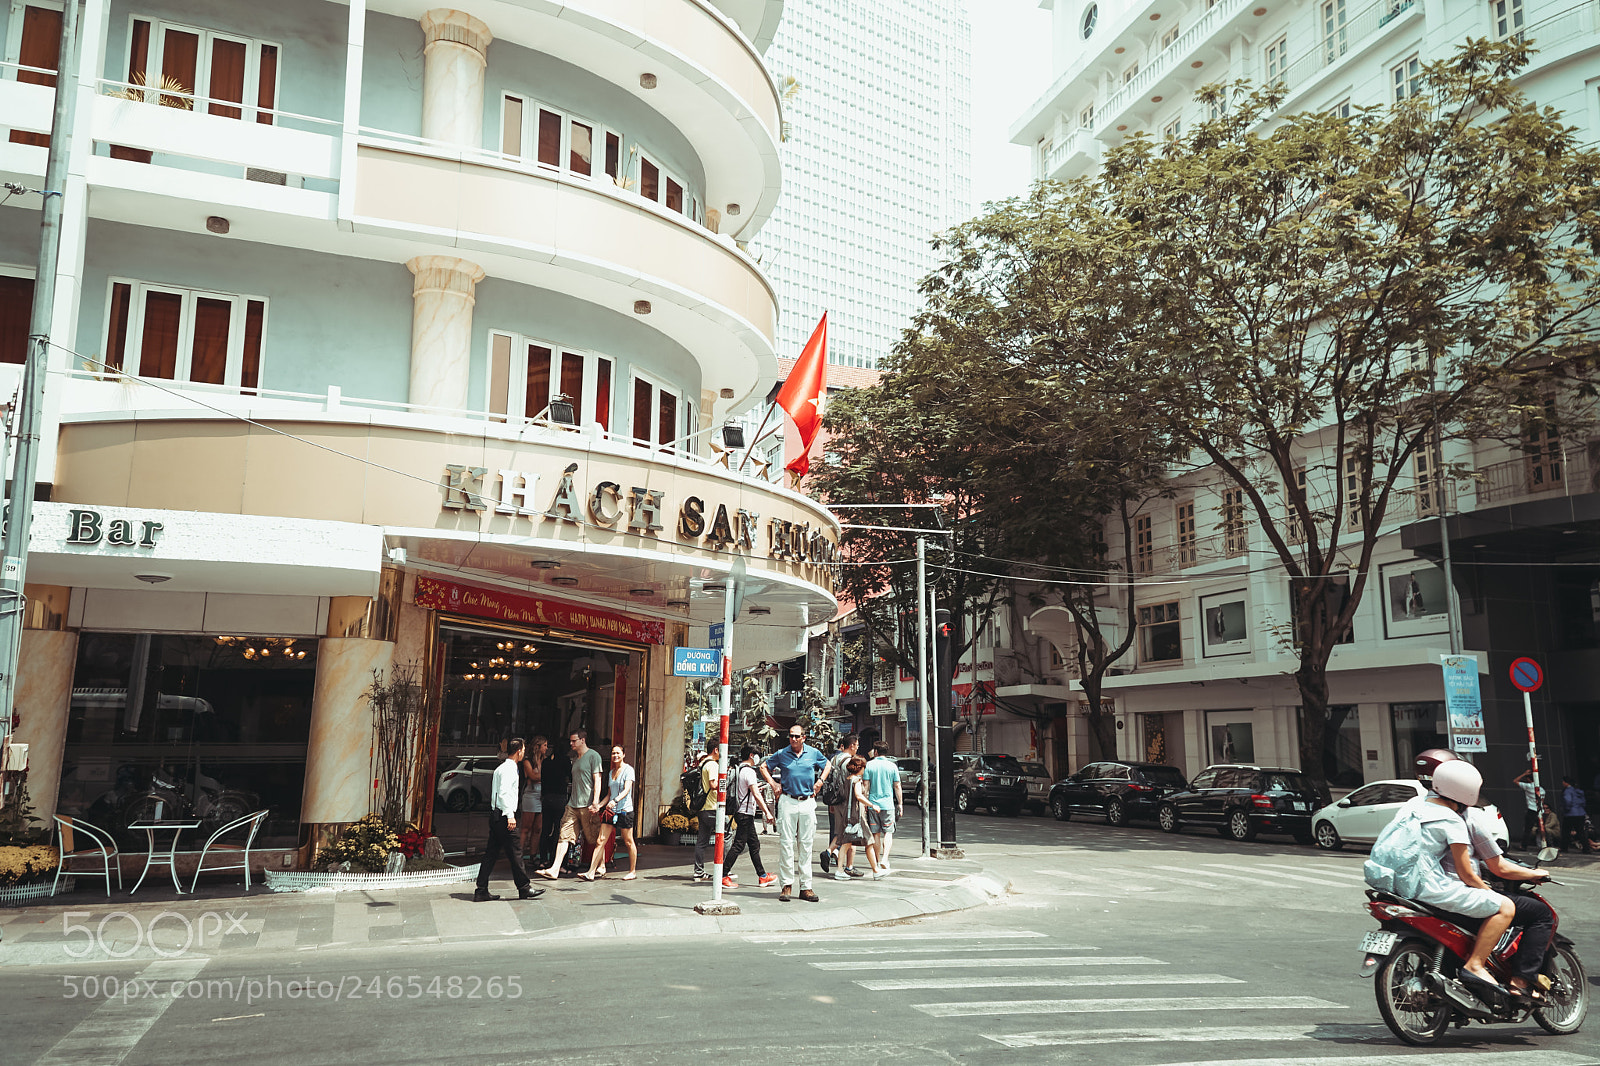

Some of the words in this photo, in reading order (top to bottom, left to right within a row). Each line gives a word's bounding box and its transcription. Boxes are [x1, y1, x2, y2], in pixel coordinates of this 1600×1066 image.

[442, 462, 665, 532] KHÁCH
[679, 495, 760, 551] SẠN
[767, 517, 835, 573] HƯƠ
[66, 509, 165, 549] Bar
[5, 564, 16, 572] 39
[569, 612, 589, 629] HAPPY
[686, 650, 711, 660] ĐƯỜNG
[676, 659, 697, 672] ĐỒNG
[699, 660, 718, 673] KHỞI
[1456, 736, 1474, 745] BIDV
